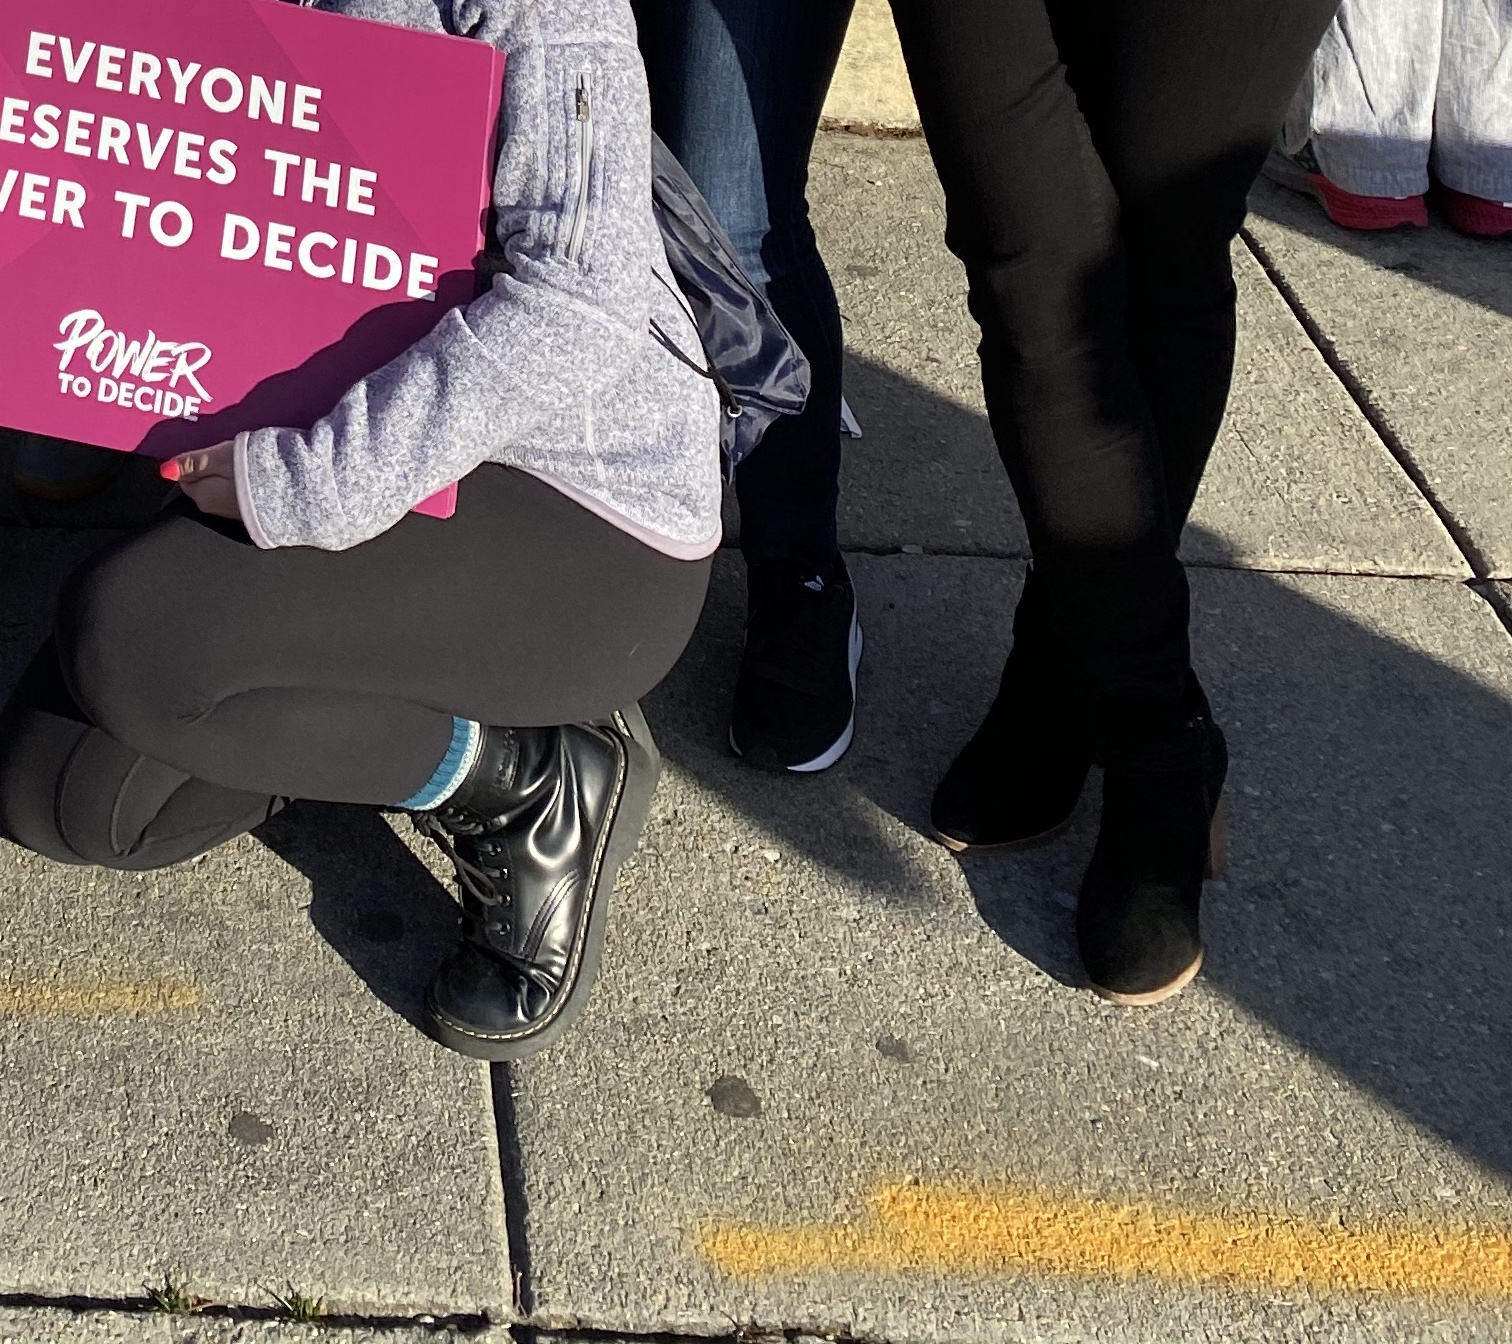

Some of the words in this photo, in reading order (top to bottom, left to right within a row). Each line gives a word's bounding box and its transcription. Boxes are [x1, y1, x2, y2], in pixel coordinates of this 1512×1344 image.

[25, 31, 322, 132] EVERYONE
[264, 148, 377, 216] THE
[114, 190, 193, 247] TO
[220, 212, 439, 302] DECIDE
[52, 309, 214, 403] POWER
[57, 372, 92, 398] TO
[97, 378, 202, 422] DECIDE
